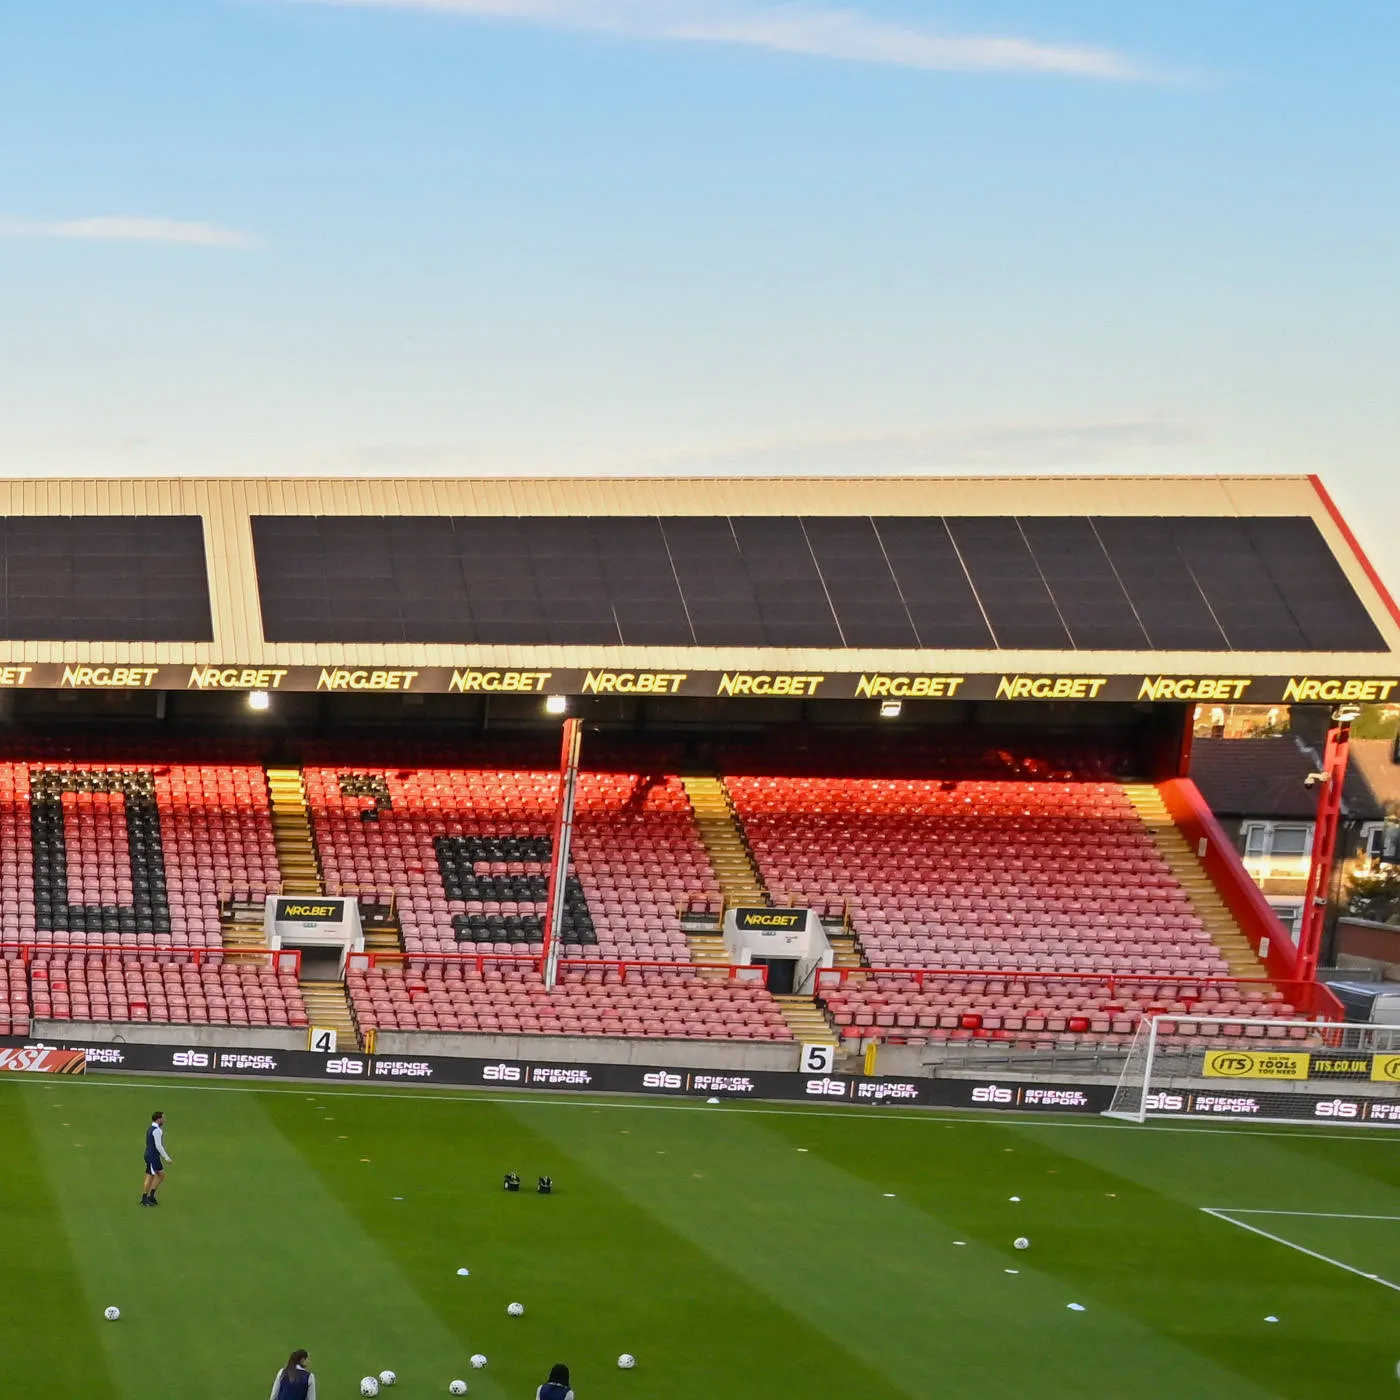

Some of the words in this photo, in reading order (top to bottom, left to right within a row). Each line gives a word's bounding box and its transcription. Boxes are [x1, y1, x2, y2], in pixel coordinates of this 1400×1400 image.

[315, 1032, 332, 1052] 4
[220, 1054, 273, 1064] SCIENCE
[807, 1047, 826, 1070] 5
[220, 1060, 233, 1068] IN
[236, 1061, 277, 1070] SPORT
[375, 1061, 429, 1071] SCIENCE
[1219, 1058, 1247, 1070] ITS
[1259, 1060, 1297, 1069] TOOLS
[1315, 1060, 1368, 1072] ITS.CO.UK
[375, 1067, 388, 1075] IN
[391, 1068, 433, 1077] SPORT
[533, 1068, 587, 1077] SCIENCE
[533, 1074, 546, 1082] IN
[549, 1075, 592, 1084] SPORT
[694, 1075, 750, 1085] SCIENCE
[694, 1082, 708, 1090] IN
[711, 1083, 754, 1092] SPORT
[858, 1083, 914, 1092] SCIENCE
[858, 1089, 872, 1097] IN
[875, 1090, 918, 1099] SPORT
[1025, 1089, 1083, 1099] SCIENCE
[1024, 1096, 1040, 1104] IN
[1042, 1097, 1087, 1106] SPORT
